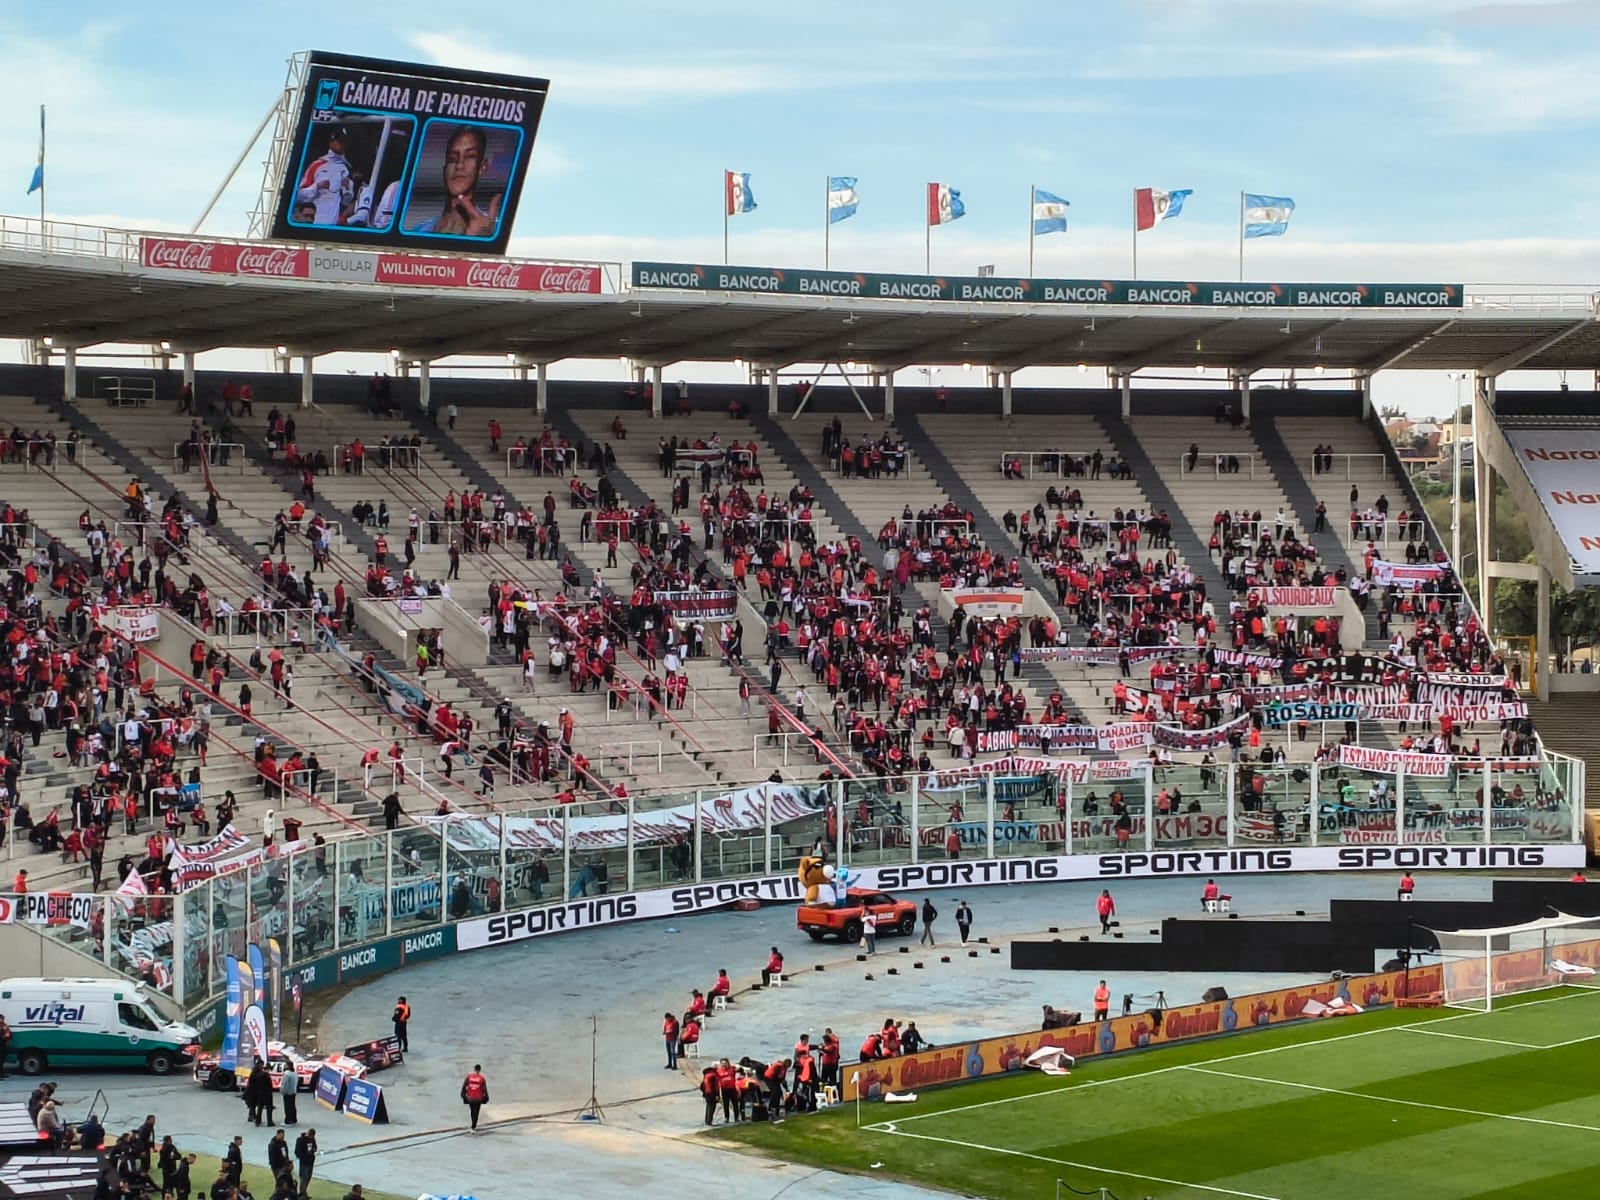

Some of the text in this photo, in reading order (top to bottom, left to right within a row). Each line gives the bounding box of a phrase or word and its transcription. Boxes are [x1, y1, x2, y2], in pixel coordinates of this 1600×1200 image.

[342, 77, 526, 122] CÁMARA DE PARECIDOS
[150, 240, 216, 269] Coca-Cola
[236, 247, 298, 275] Coca-Cola
[314, 258, 373, 273] POPULAR
[381, 262, 455, 278] WILLINGTON
[467, 262, 522, 289] Coca-Cola
[540, 267, 592, 292] Coca-Cola
[639, 270, 699, 287] BANCOR
[719, 274, 779, 290] BANCOR
[799, 278, 860, 294] BANCOR
[880, 282, 941, 298] BANCOR
[962, 285, 1024, 299] BANCOR
[1044, 287, 1107, 301] BANCOR
[1128, 289, 1191, 302] BANCOR
[1212, 290, 1276, 304] BANCOR
[1298, 290, 1361, 305] BANCOR
[1384, 291, 1449, 305] BANCOR
[1345, 682, 1409, 705] CANTINA
[1265, 704, 1354, 724] ROSARIO
[1498, 702, 1506, 719] A
[1140, 723, 1152, 734] DE
[986, 730, 1016, 751] ABRIL
[1343, 746, 1389, 769] ESTAMOS
[957, 825, 1032, 842] RINCON
[1039, 820, 1091, 841] RIVER
[1099, 850, 1292, 876] SPORTING
[1338, 847, 1544, 868] SPORTING
[877, 858, 1058, 889] SPORTING
[672, 877, 799, 911] SPORTI
[28, 896, 91, 922] PACHECO
[488, 895, 637, 942] SPORTING
[405, 932, 443, 953] BANCOR
[341, 948, 376, 971] BANCOR
[1166, 999, 1238, 1039] Quini 6
[1099, 1021, 1116, 1053] 6
[901, 1043, 984, 1087] Quini 6
